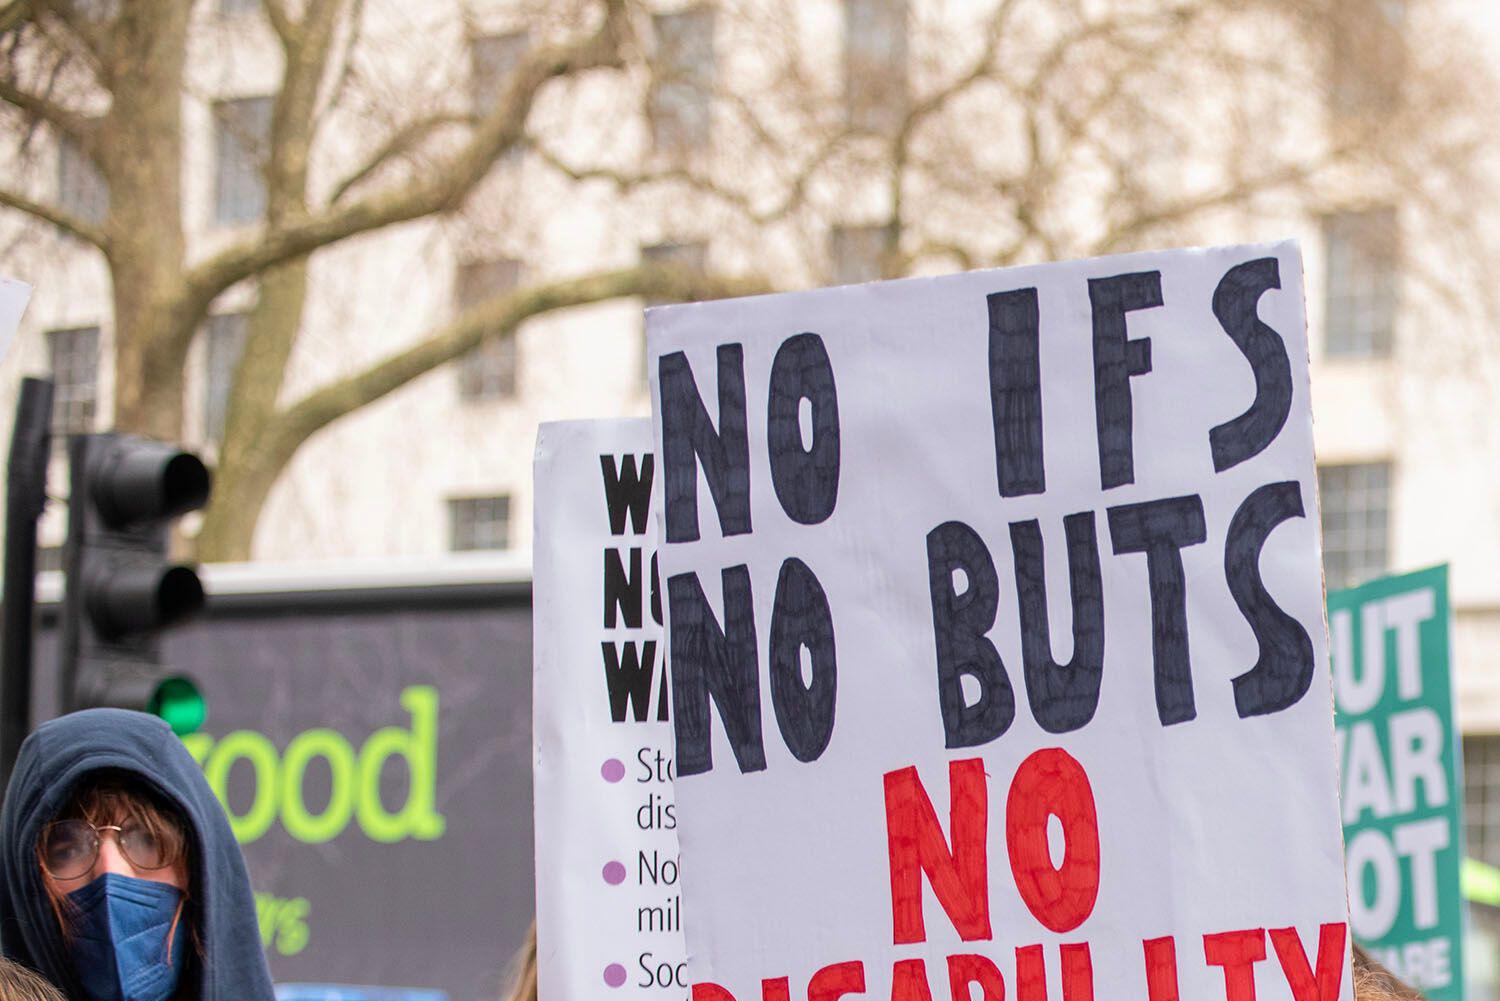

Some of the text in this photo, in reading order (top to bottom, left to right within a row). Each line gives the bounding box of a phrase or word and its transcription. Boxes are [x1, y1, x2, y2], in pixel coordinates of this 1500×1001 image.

[658, 256, 1294, 544] NO IFS
[667, 480, 1316, 778] NO BUTS
[1330, 586, 1437, 717] UT
[637, 793, 677, 829] dis
[1336, 706, 1449, 827] AR
[639, 850, 680, 886] No
[883, 747, 1101, 945] NO
[638, 895, 680, 932] mil
